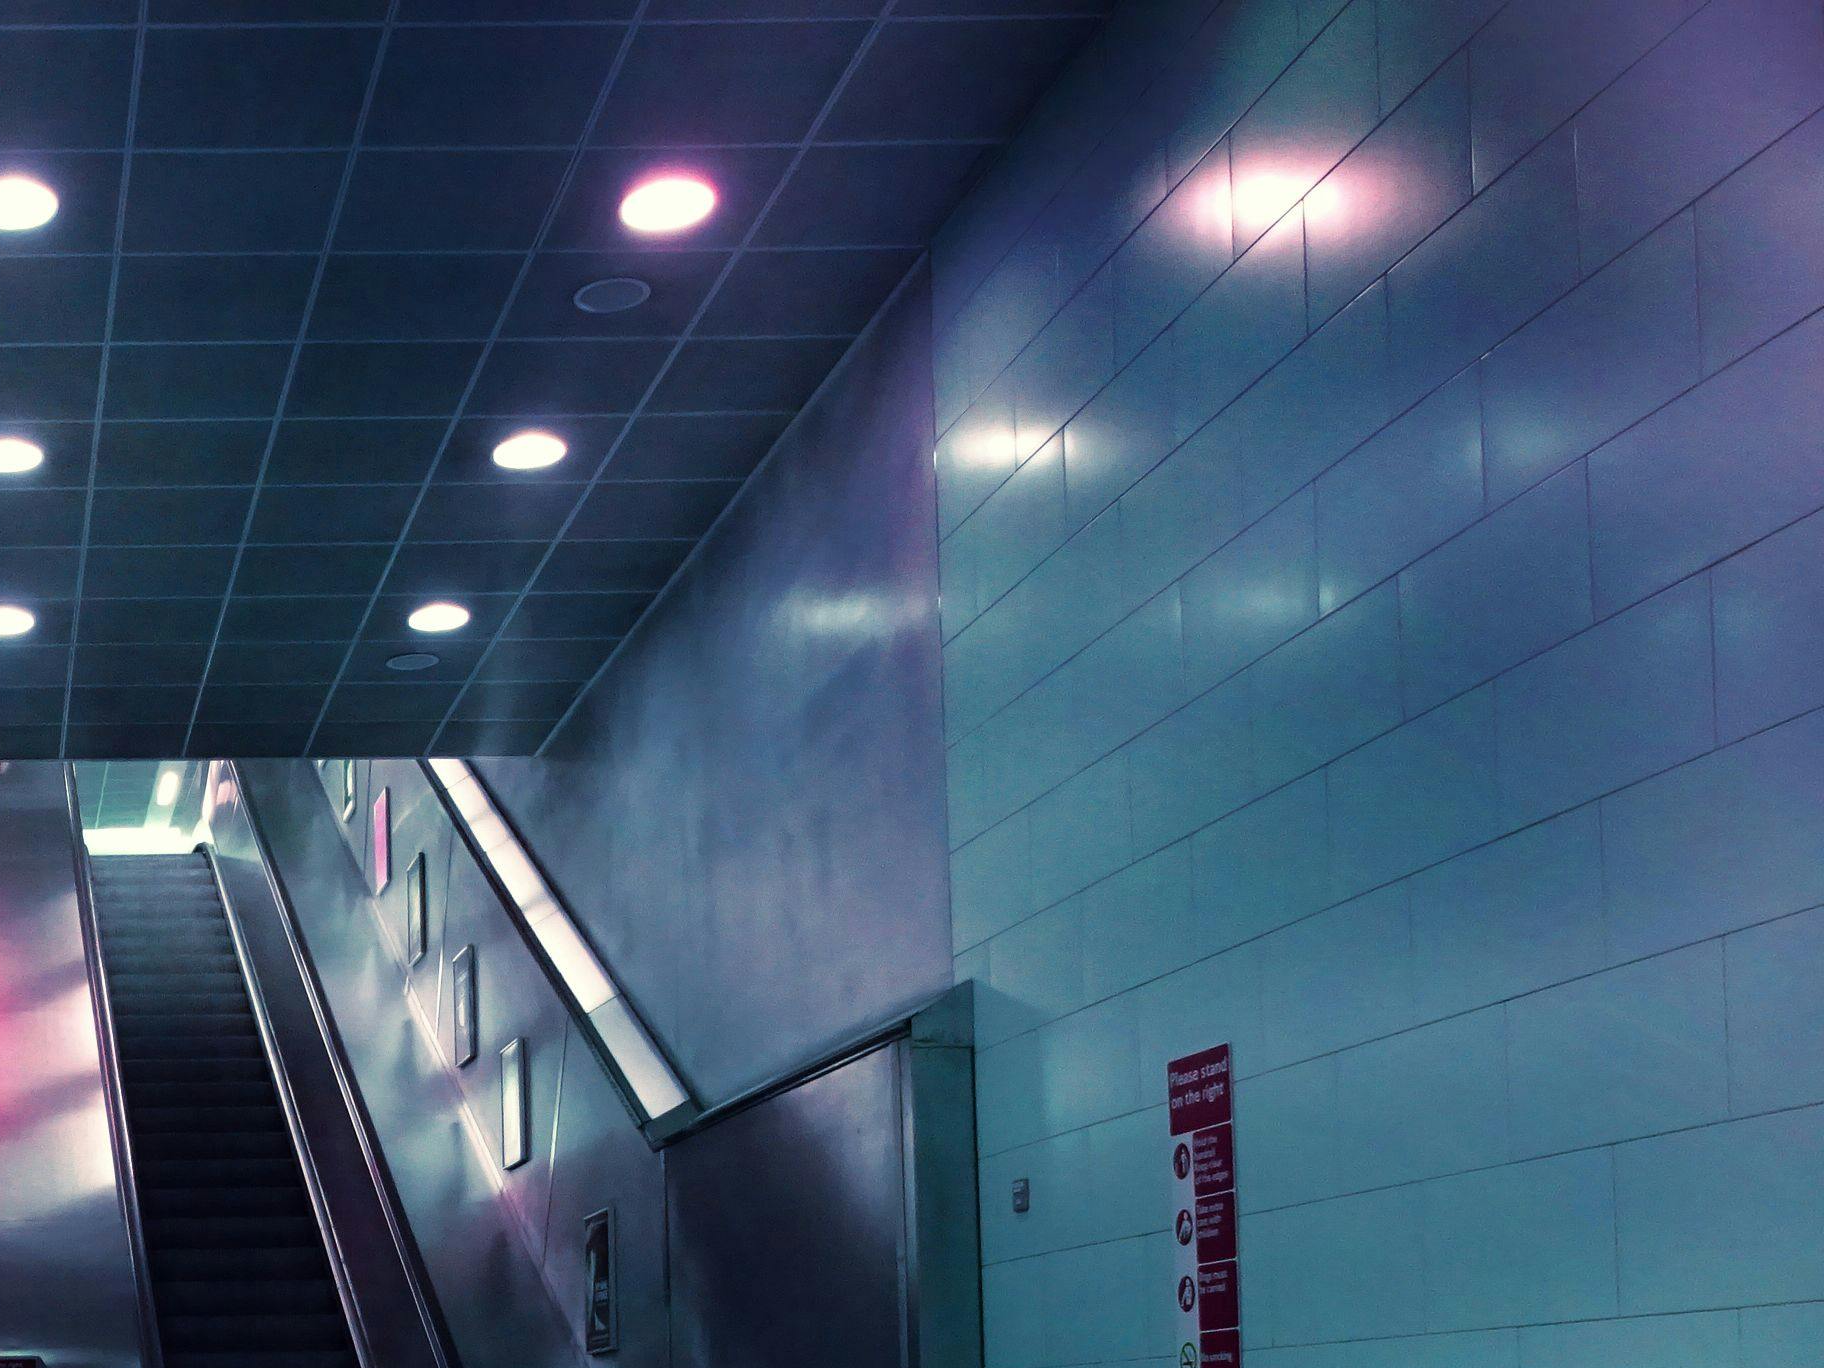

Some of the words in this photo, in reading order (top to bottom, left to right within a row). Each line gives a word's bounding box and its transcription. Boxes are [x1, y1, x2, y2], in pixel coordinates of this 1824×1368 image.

[1170, 1070, 1200, 1088] Please
[1200, 1056, 1228, 1079] stand
[1171, 1096, 1183, 1109] on
[1185, 1089, 1201, 1104] the
[1202, 1082, 1224, 1103] right
